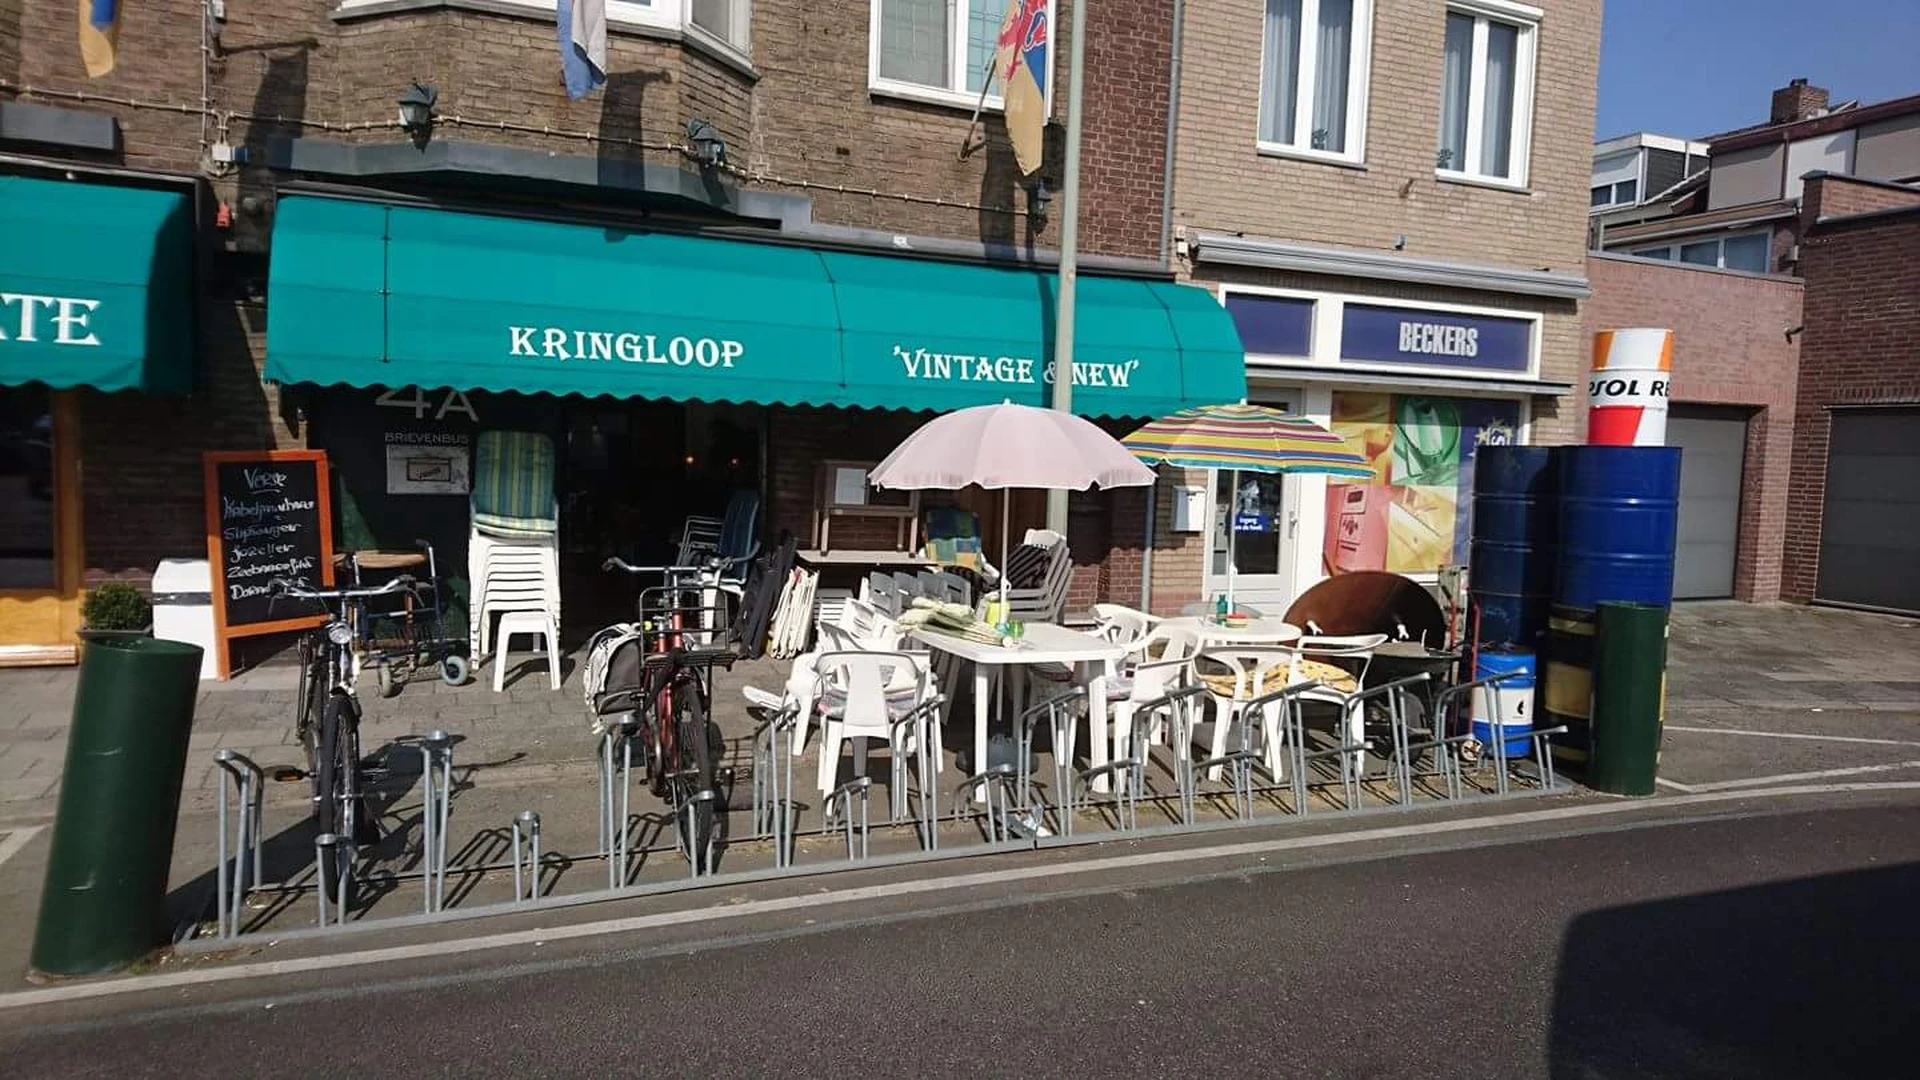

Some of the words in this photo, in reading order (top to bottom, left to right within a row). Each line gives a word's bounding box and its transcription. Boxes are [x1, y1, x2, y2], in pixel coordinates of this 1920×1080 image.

[0, 293, 101, 346] TE
[508, 326, 744, 368] KRINGLOOP
[1398, 321, 1479, 358] BECKERS
[374, 387, 480, 422] 4A
